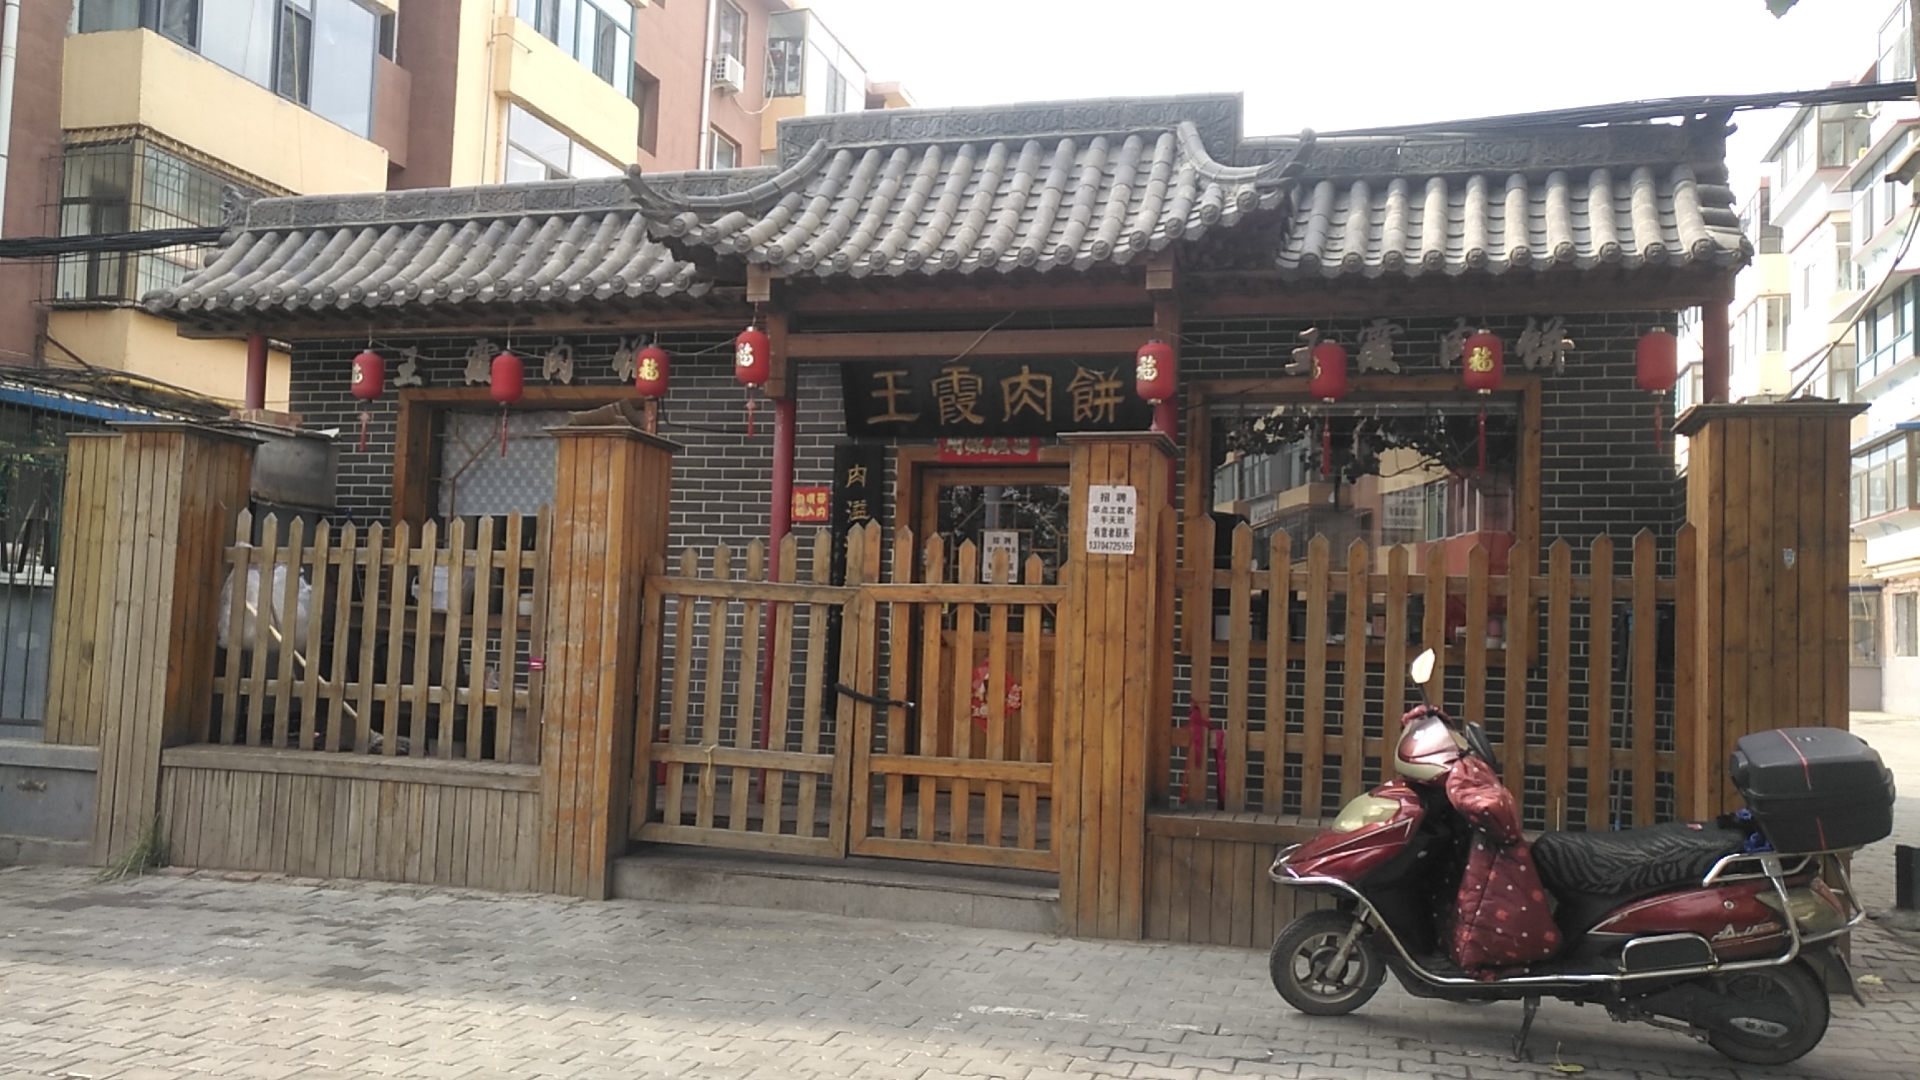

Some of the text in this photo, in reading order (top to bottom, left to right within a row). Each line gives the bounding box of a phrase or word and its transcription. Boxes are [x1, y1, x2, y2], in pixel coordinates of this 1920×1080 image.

[736, 342, 754, 367] 福
[1469, 346, 1494, 372] 福
[639, 358, 659, 381] 福
[1136, 355, 1158, 381] 福
[867, 365, 1125, 425] 王霞肉餅
[1100, 492, 1126, 503] 招聘
[1092, 506, 1134, 515] 早点工数名
[1094, 527, 1130, 538] 有意者联系
